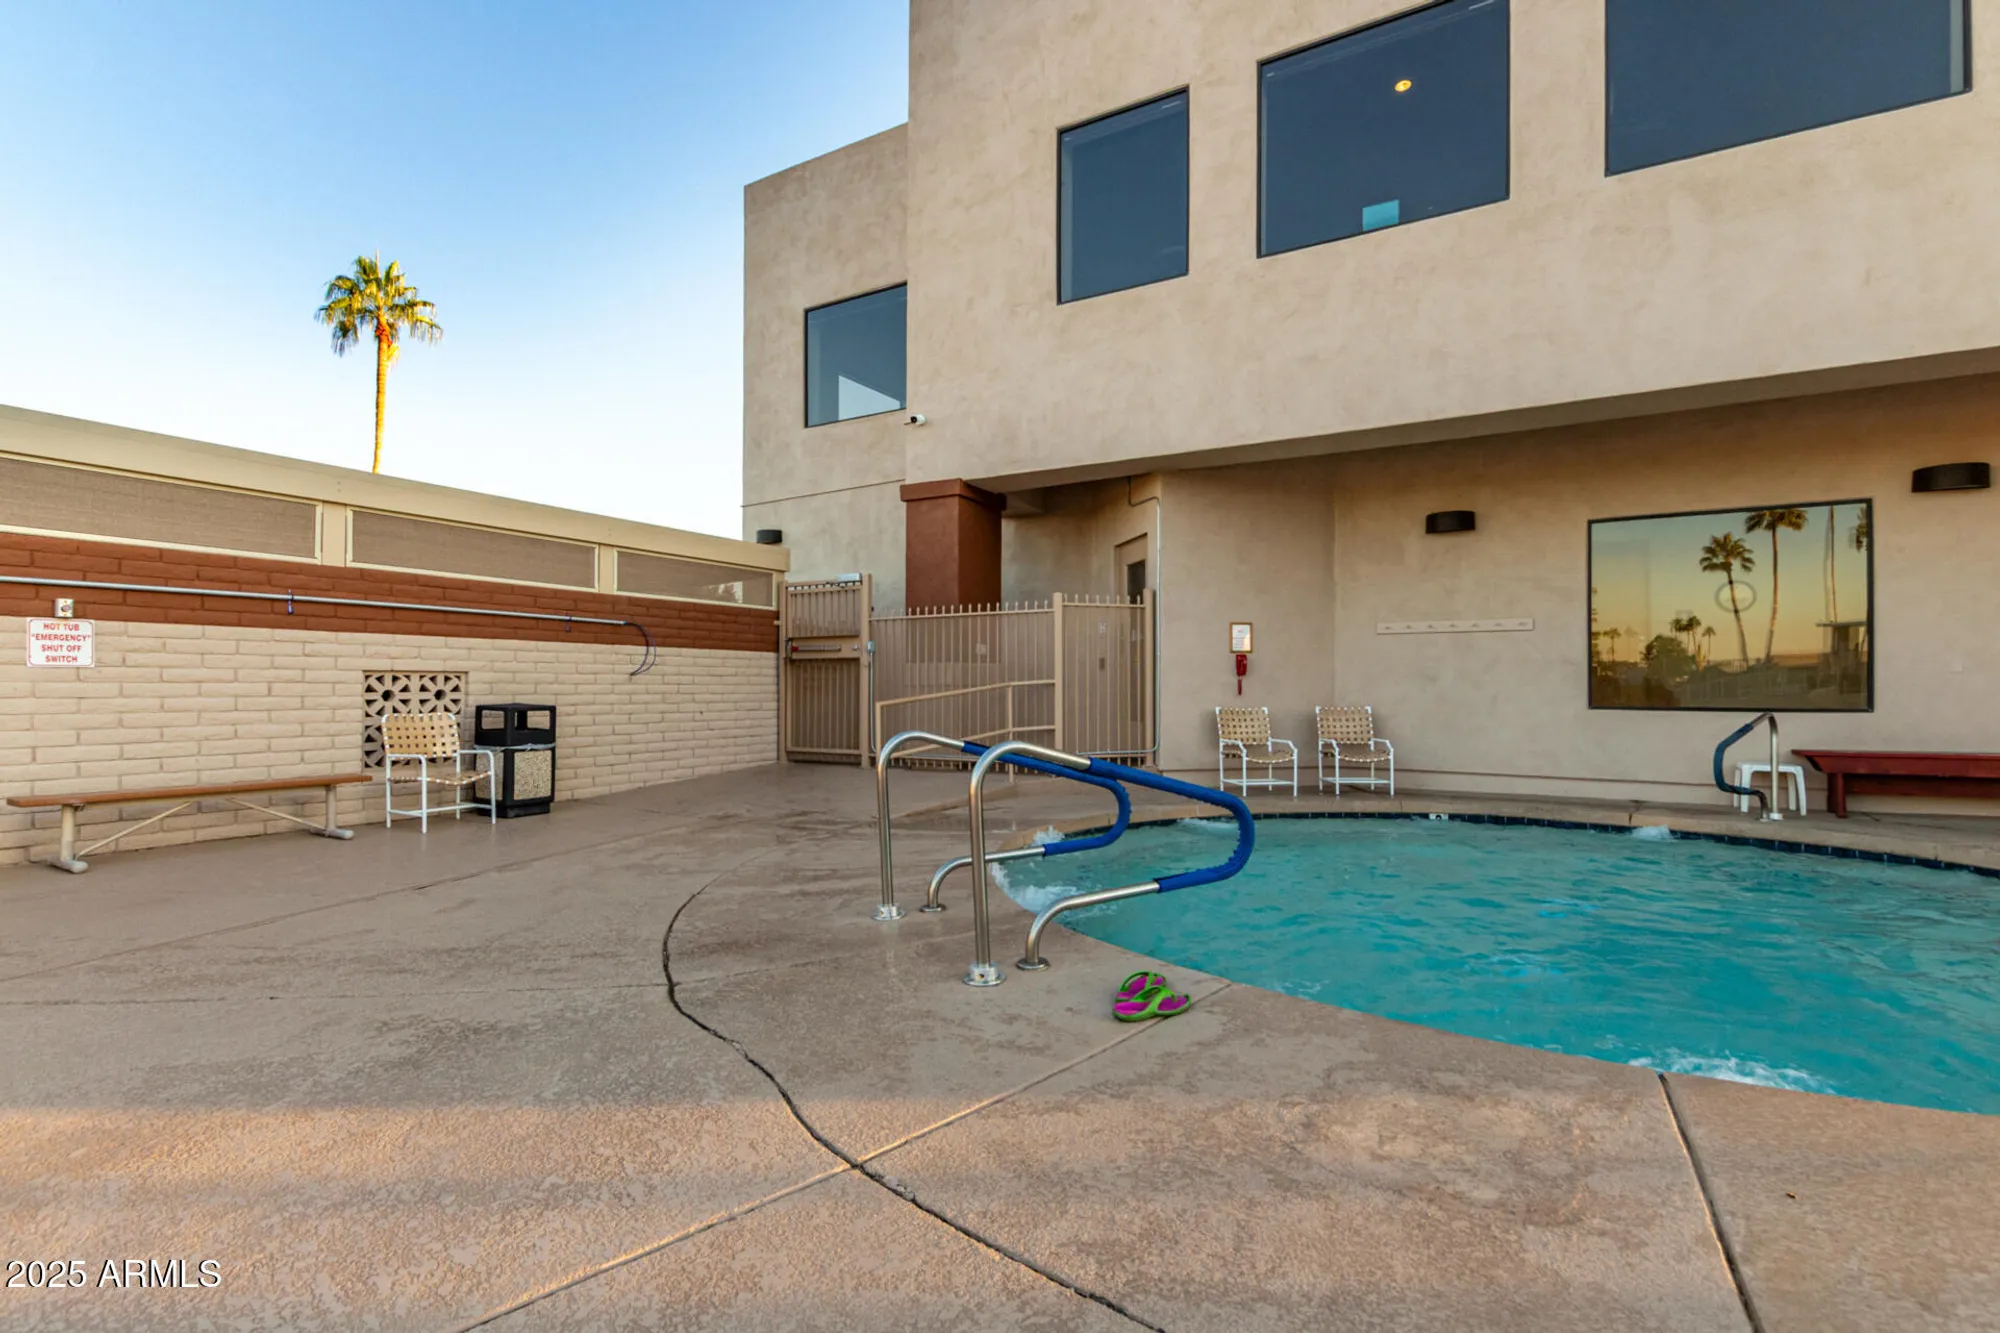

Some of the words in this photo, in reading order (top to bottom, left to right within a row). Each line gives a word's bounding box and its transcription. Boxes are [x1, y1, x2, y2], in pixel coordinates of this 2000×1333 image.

[43, 623, 60, 631] HOT
[63, 623, 80, 631] TUB
[45, 655, 78, 663] SWITCH
